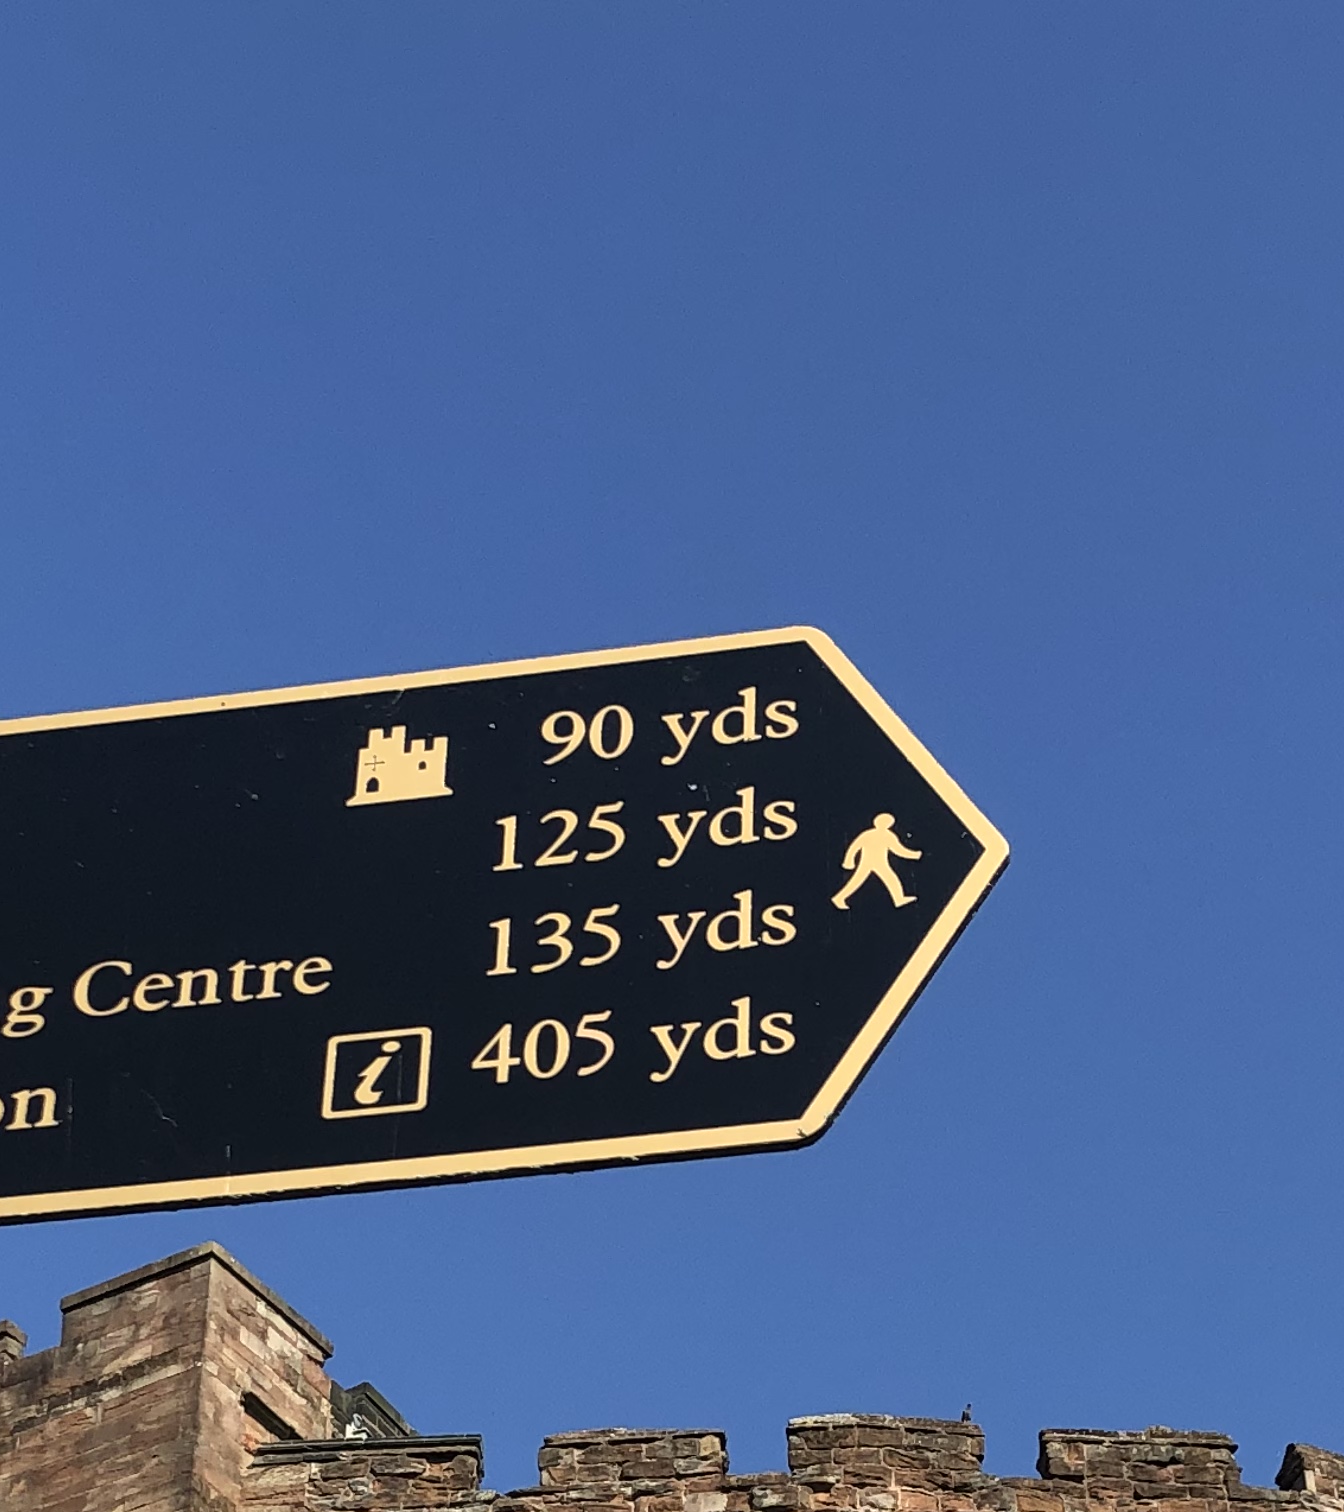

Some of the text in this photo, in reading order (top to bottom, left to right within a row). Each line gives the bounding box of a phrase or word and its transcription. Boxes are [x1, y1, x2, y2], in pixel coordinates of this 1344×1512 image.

[541, 704, 634, 765] 90
[661, 686, 799, 766] yds
[493, 800, 626, 872] 125
[657, 786, 798, 868] yds
[73, 957, 333, 1016] Centre
[486, 903, 621, 976] 135
[656, 889, 797, 970] yds
[471, 1010, 615, 1083] 405
[650, 996, 796, 1083] yds
